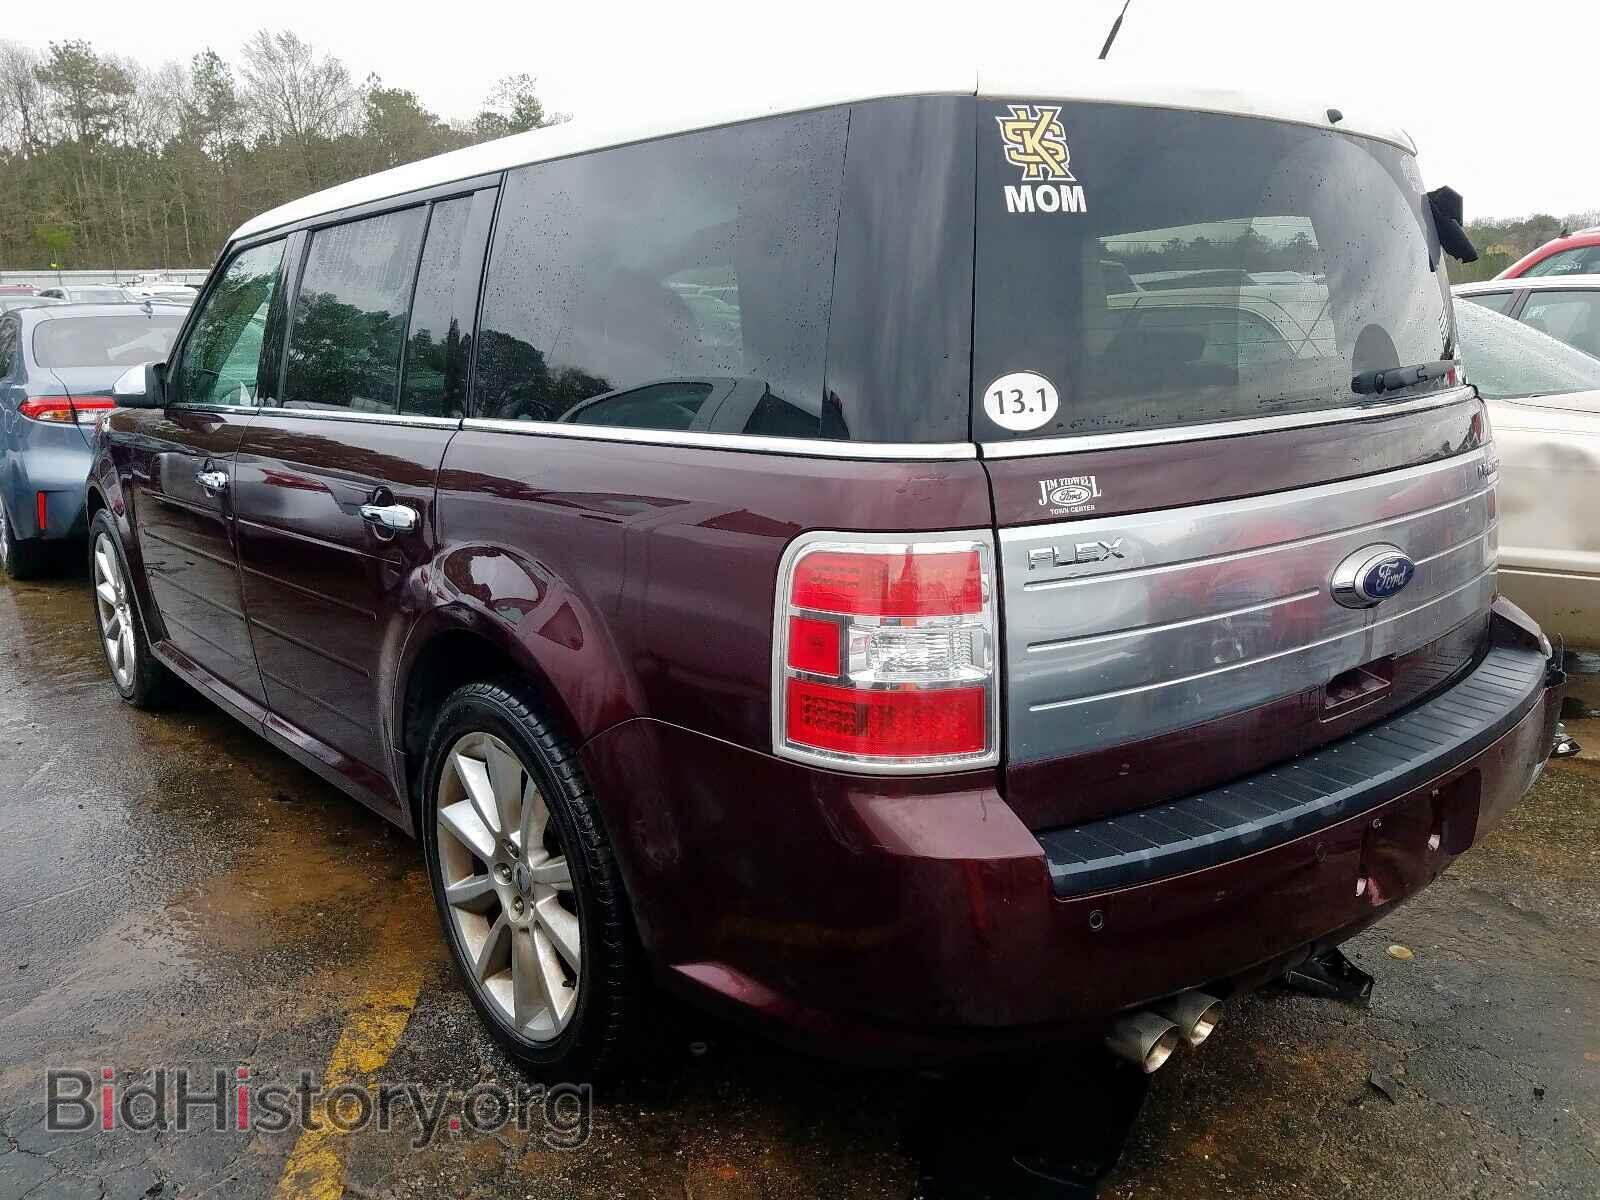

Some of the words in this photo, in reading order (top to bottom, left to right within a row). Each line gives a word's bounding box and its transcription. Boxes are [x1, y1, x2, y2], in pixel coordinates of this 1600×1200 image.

[1004, 185, 1087, 213] MOM
[993, 388, 1047, 415] 13.1
[1070, 504, 1096, 513] CENTER
[1027, 537, 1125, 571] FLEX
[1375, 560, 1408, 593] Ford
